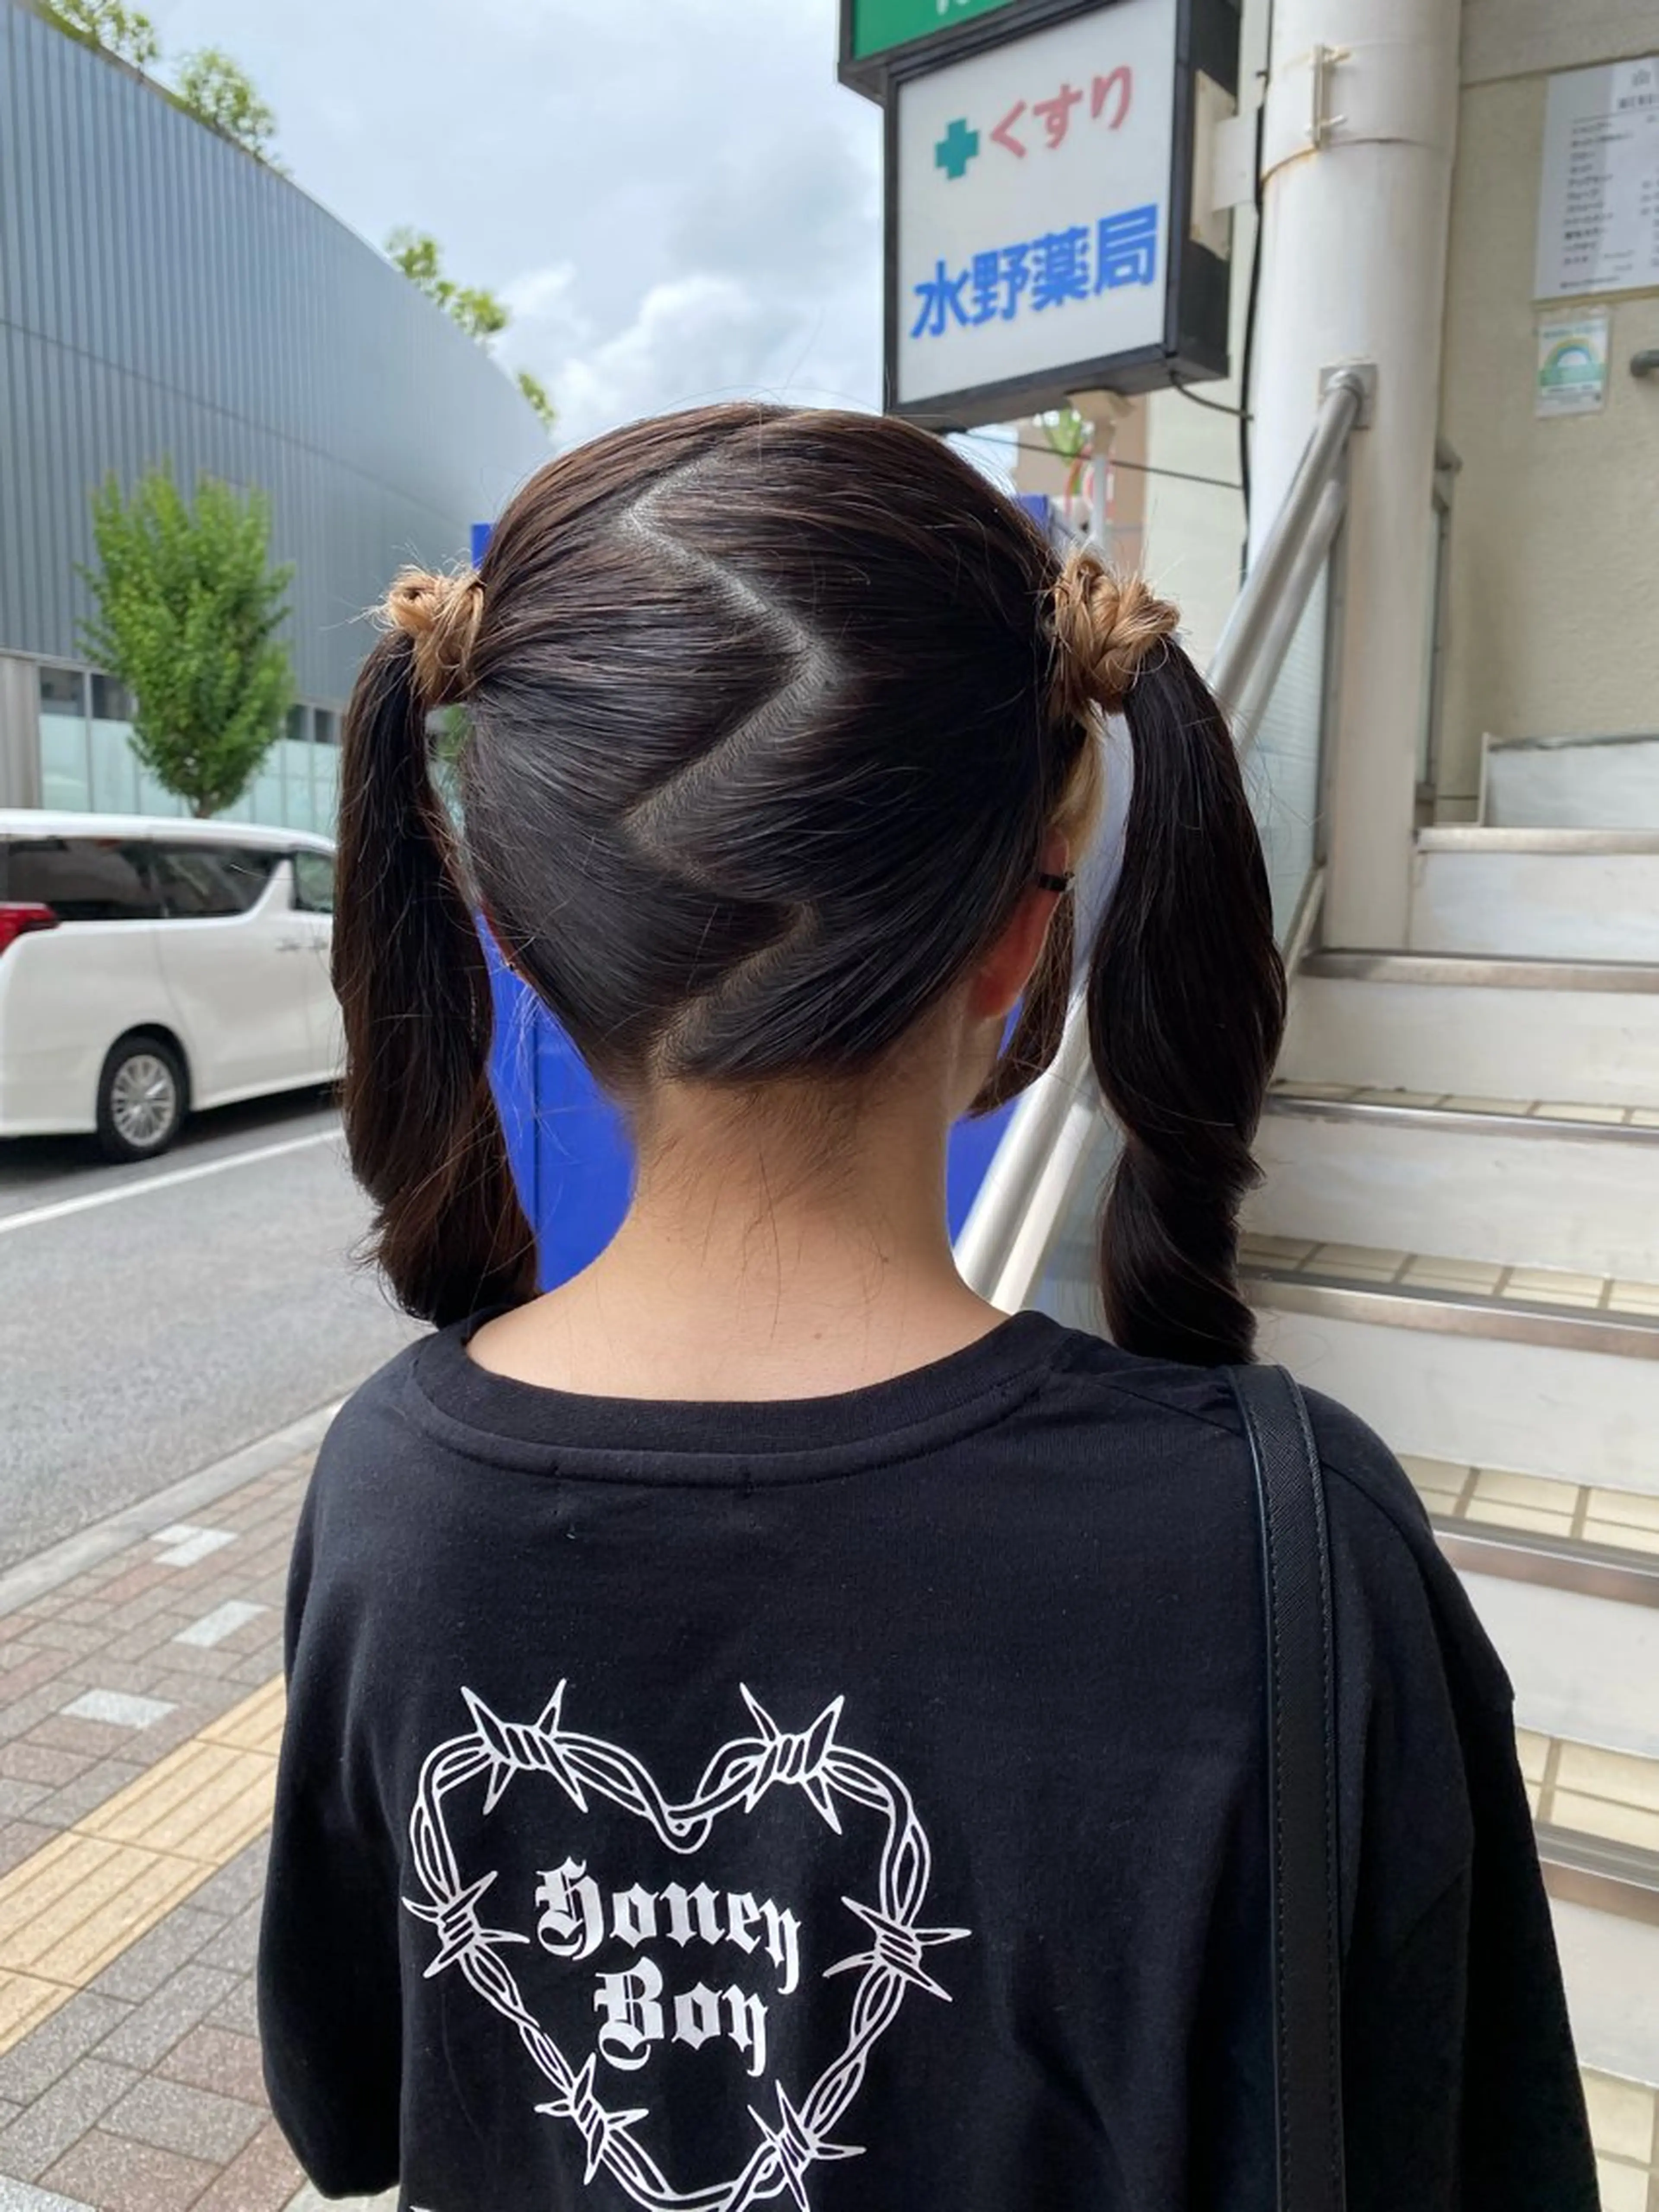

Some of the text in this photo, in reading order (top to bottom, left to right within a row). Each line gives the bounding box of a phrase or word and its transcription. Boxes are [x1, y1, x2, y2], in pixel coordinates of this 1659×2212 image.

[991, 66, 1131, 158] くすり
[910, 203, 1159, 339] 水野薬局
[535, 1856, 802, 1994] Honey
[594, 1956, 769, 2077] Boy
